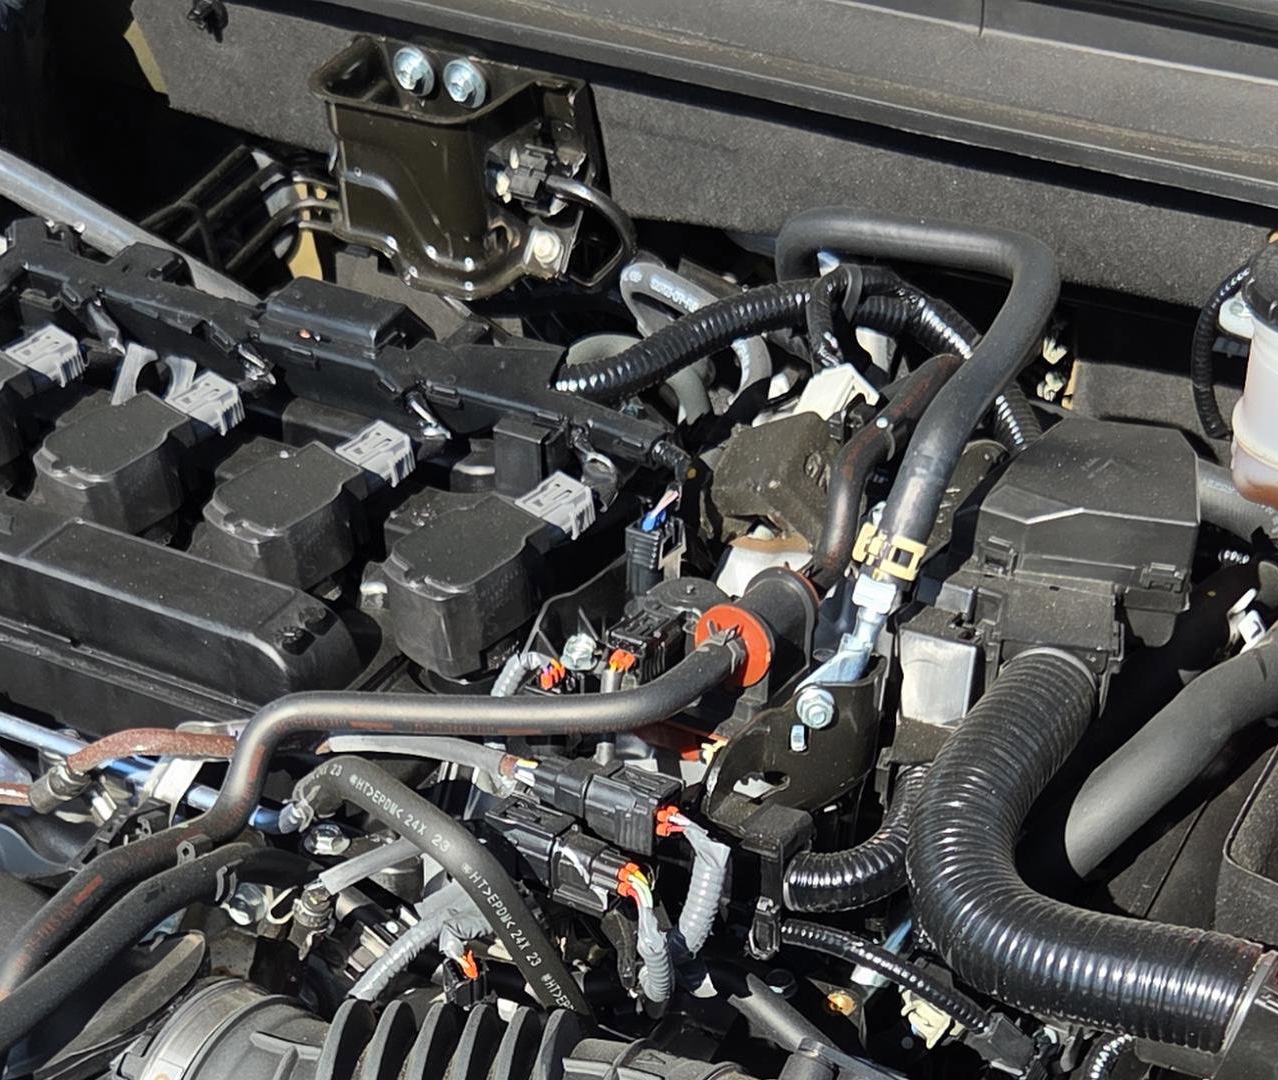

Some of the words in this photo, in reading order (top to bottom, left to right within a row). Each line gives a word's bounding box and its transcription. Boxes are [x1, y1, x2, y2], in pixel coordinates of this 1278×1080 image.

[329, 763, 342, 776] 23
[403, 814, 426, 836] 24X
[432, 834, 451, 852] 23
[510, 930, 532, 951] 24X
[526, 953, 543, 968] 23
